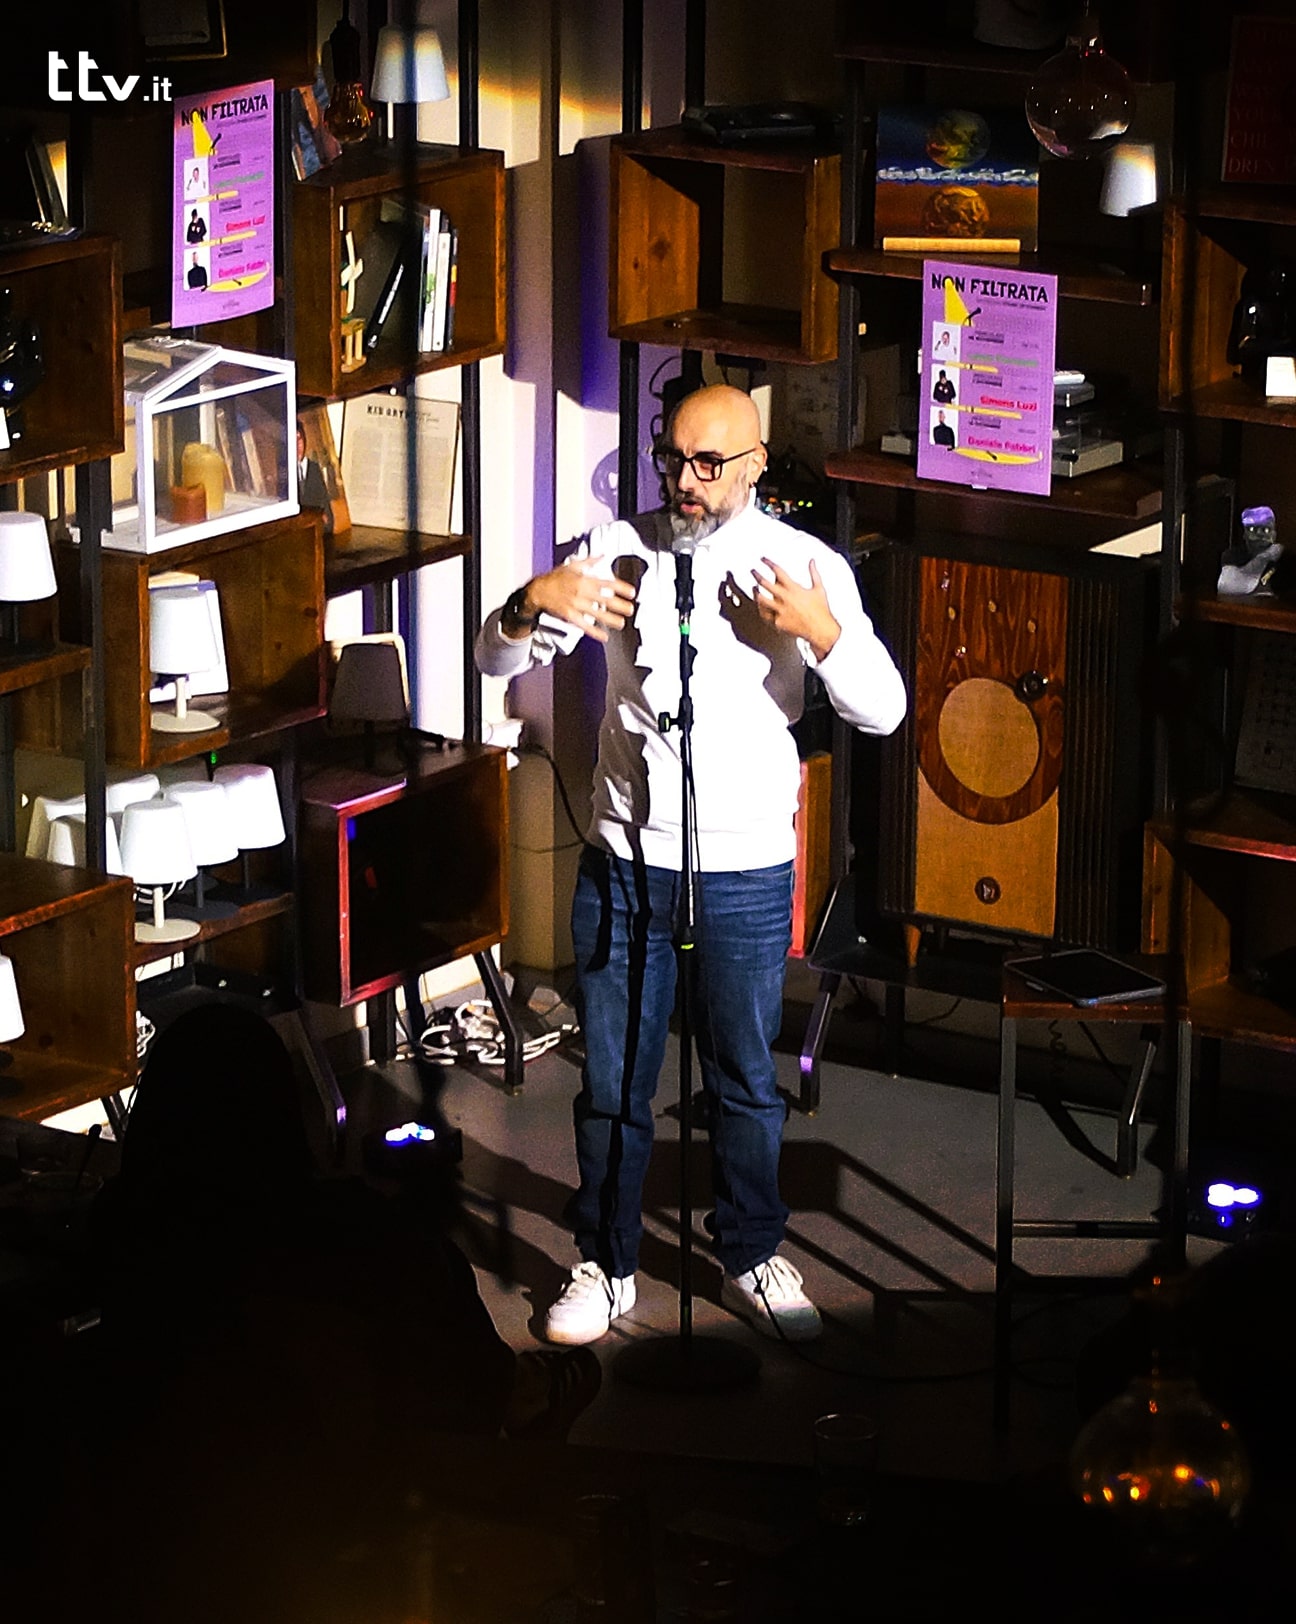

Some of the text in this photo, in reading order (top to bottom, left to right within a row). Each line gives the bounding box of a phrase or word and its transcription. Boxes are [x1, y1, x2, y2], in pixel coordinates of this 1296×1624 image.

[181, 106, 208, 127] NON
[211, 94, 268, 121] FILTRATA
[931, 273, 1049, 303] NON FILTRATA
